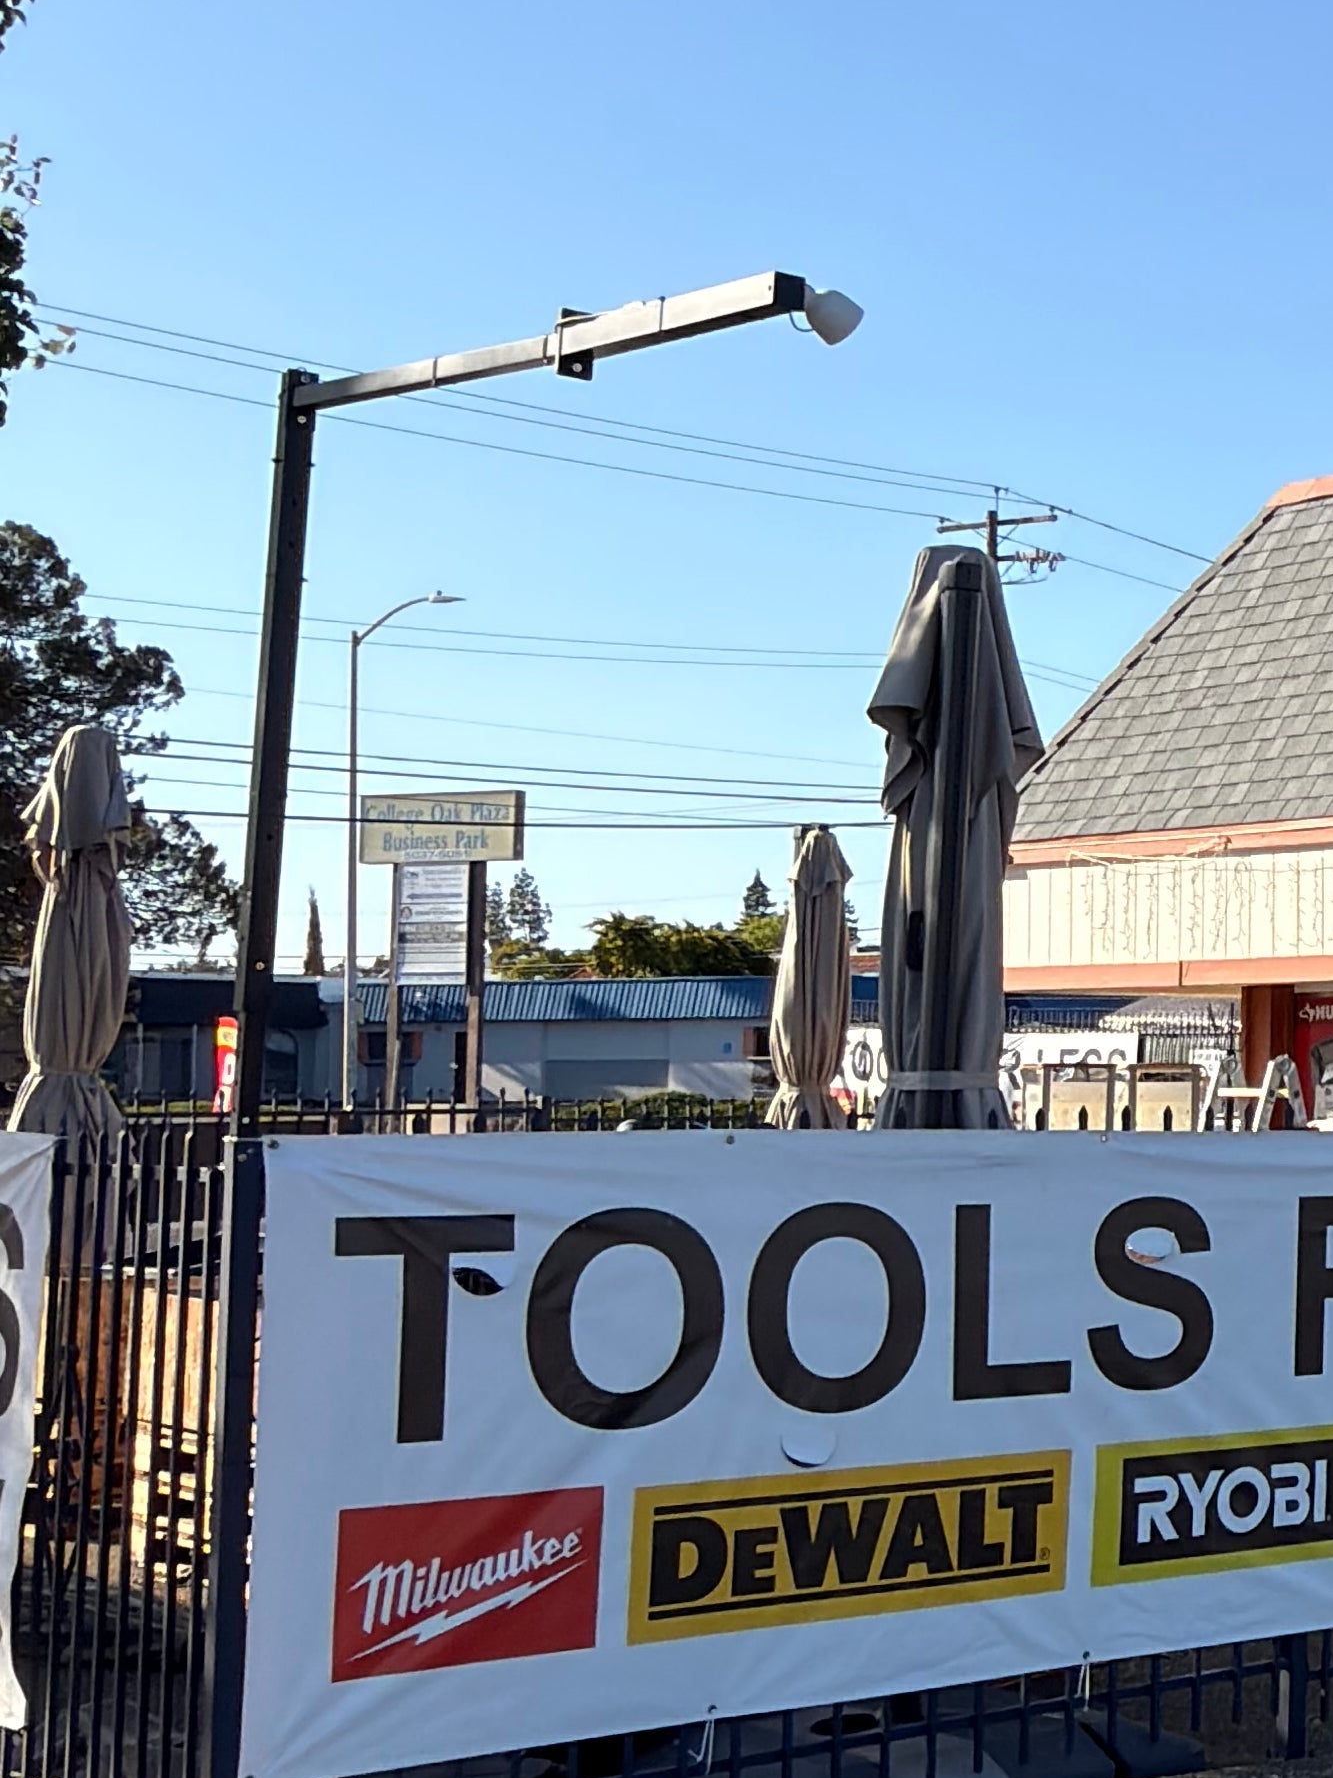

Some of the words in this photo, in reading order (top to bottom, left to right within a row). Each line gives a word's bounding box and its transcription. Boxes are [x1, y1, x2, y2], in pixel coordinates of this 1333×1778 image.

[366, 803, 424, 830] College
[431, 802, 462, 822] Oak
[470, 803, 510, 822] Plaza
[383, 830, 448, 852] Business
[455, 829, 490, 850] Park
[335, 1196, 1214, 1444] TOOLS
[648, 1481, 1054, 1608] DEWALT
[1133, 1458, 1328, 1545] RYOBI
[348, 1528, 584, 1634] Milwaukee
